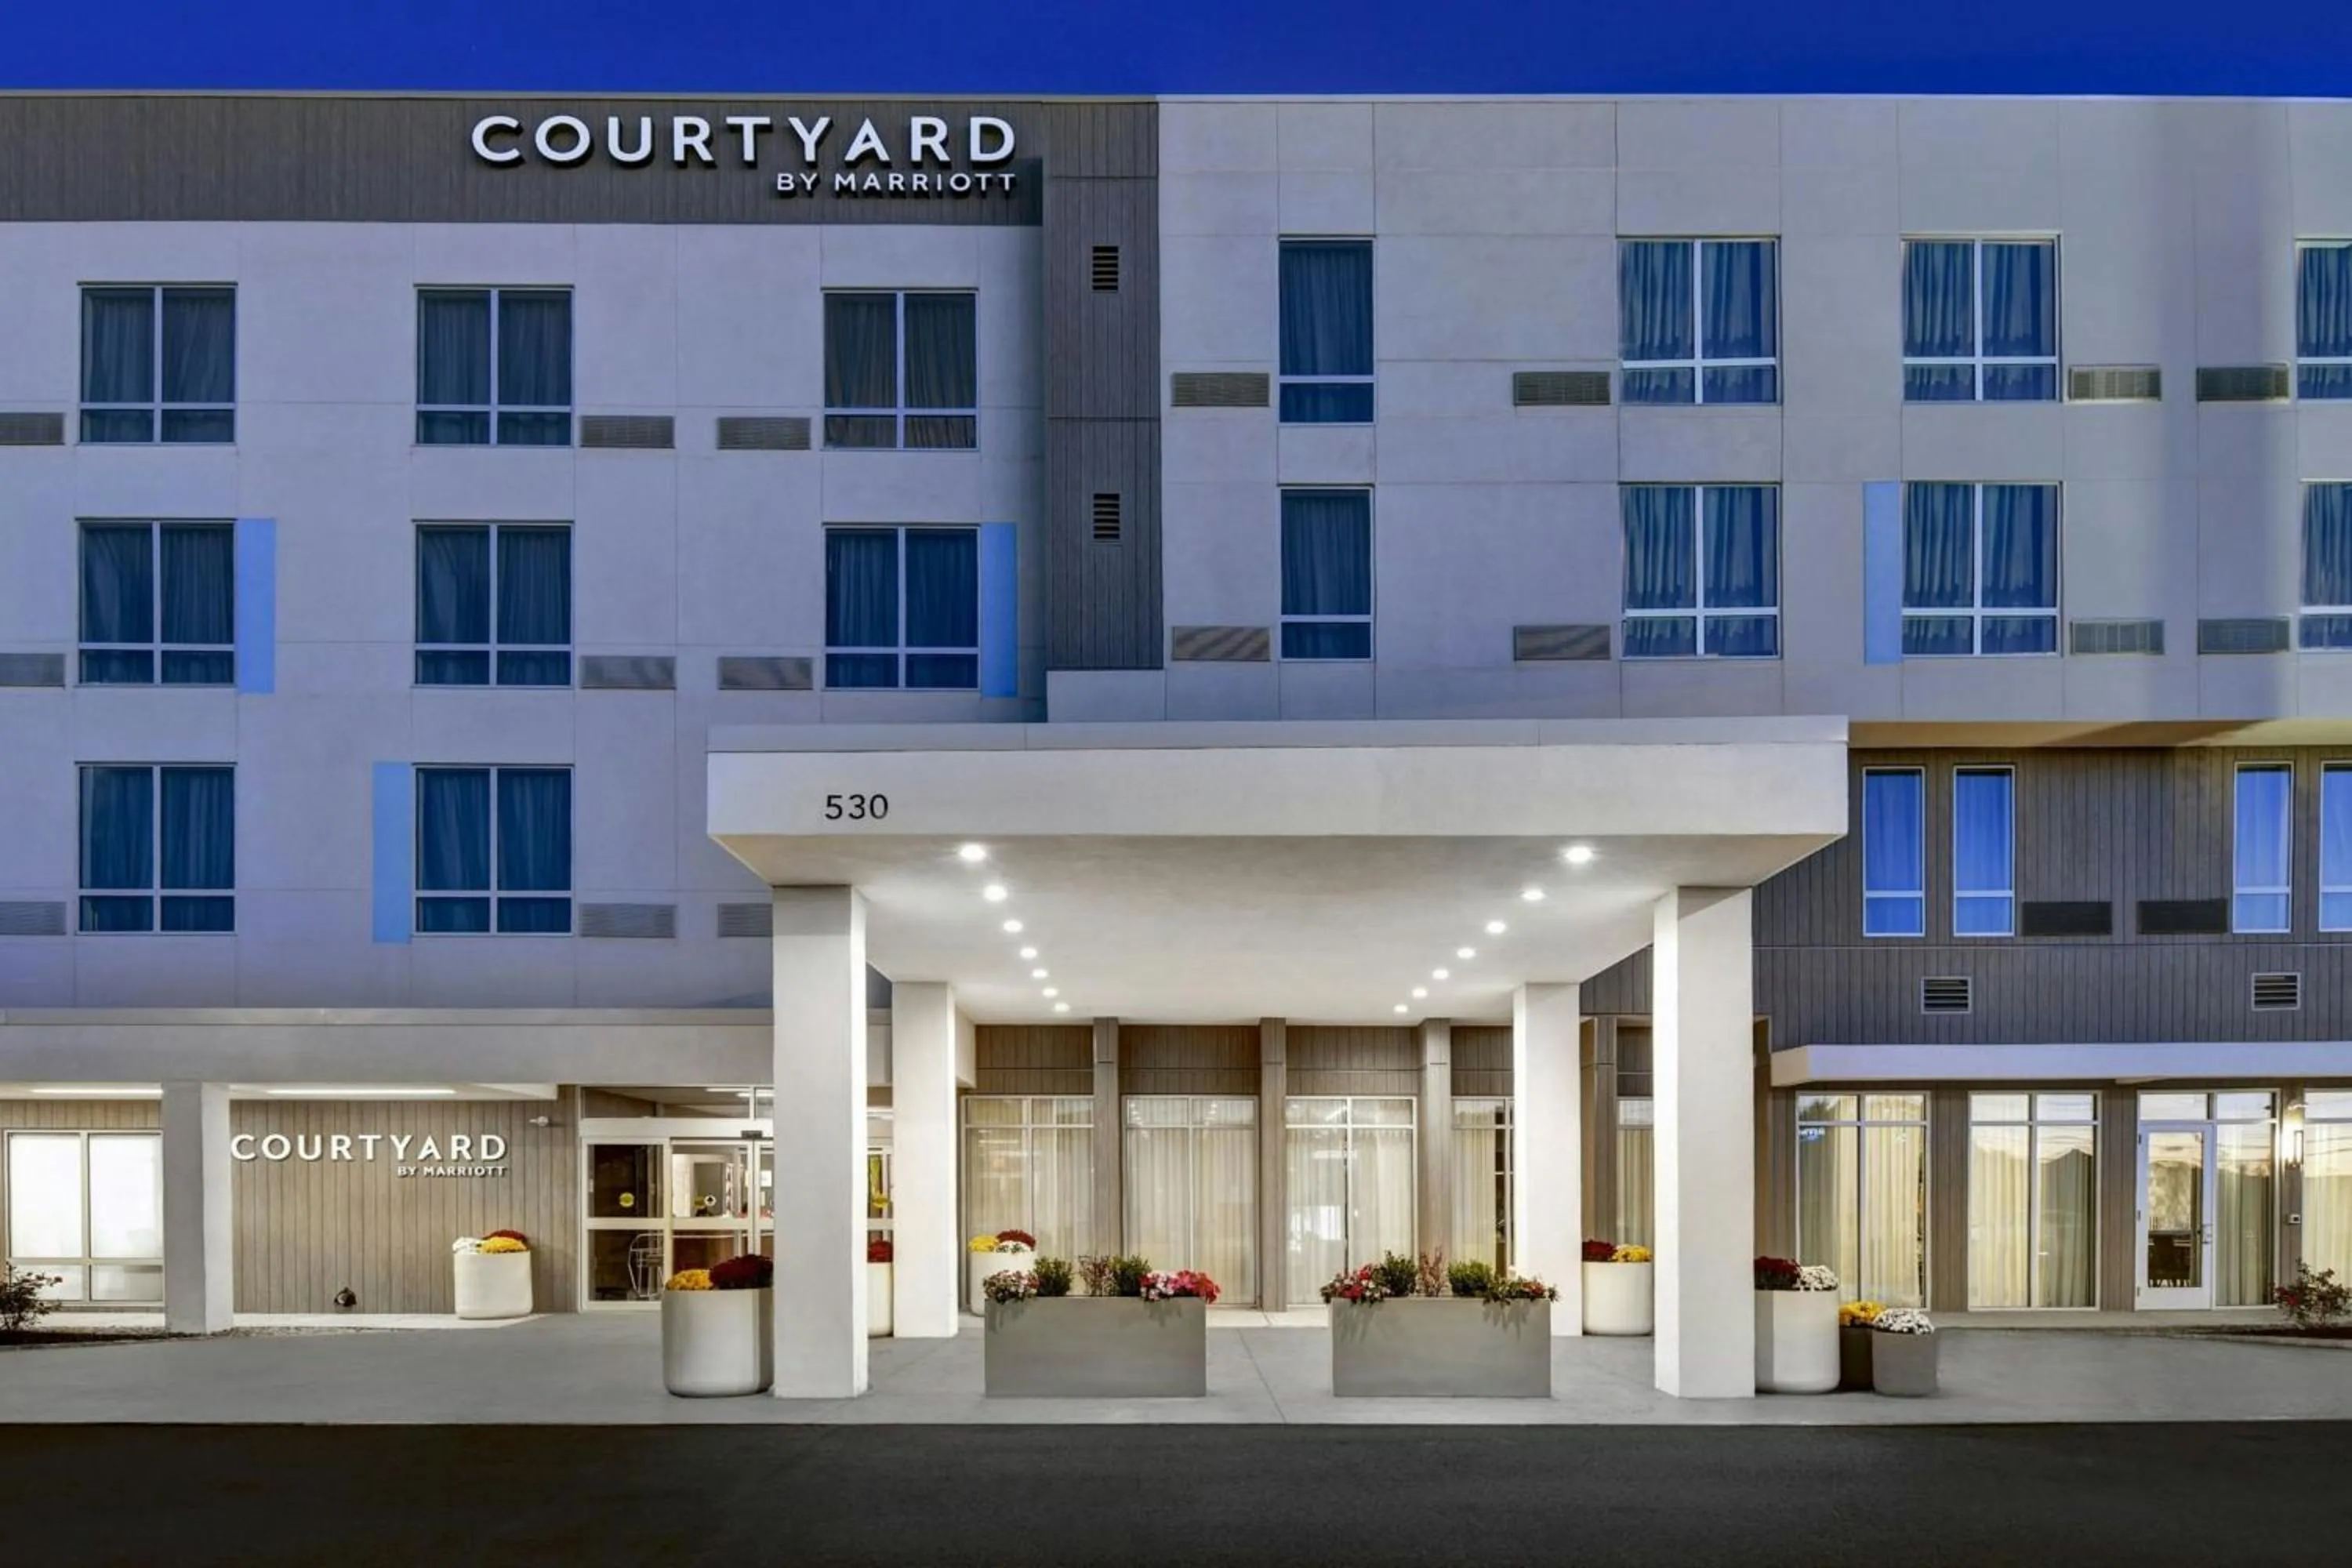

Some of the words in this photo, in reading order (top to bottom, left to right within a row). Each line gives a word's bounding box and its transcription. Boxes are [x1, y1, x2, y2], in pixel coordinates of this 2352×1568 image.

[470, 114, 1016, 163] COURTYARD
[776, 172, 818, 192] BY
[834, 172, 1017, 193] MARRIOTT
[824, 793, 888, 820] 530
[230, 1134, 506, 1161] COURTYARD
[397, 1165, 417, 1177] BY
[423, 1165, 506, 1178] MARRIOTT
